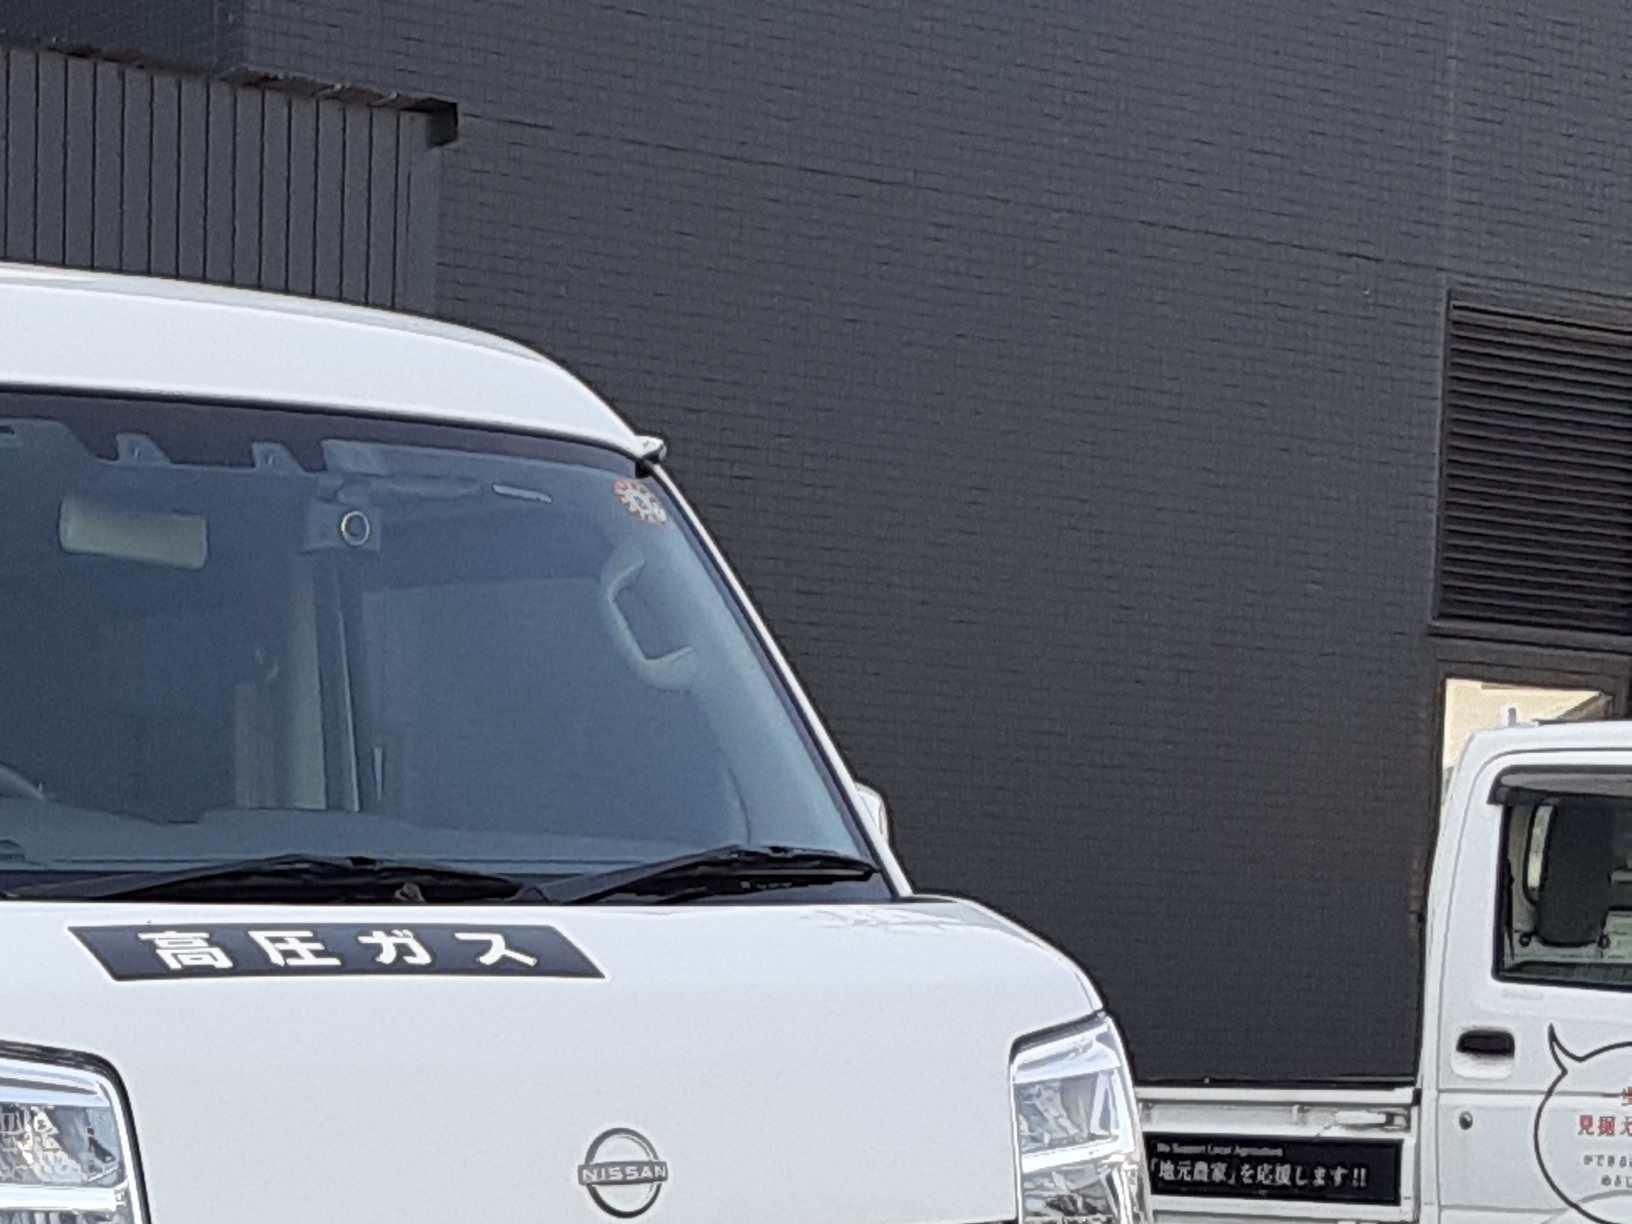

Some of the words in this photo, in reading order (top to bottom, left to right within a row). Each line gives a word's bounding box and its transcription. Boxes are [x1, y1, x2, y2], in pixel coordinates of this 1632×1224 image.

[138, 930, 538, 970] 高圧ガス
[582, 1165, 666, 1182] NISSAN
